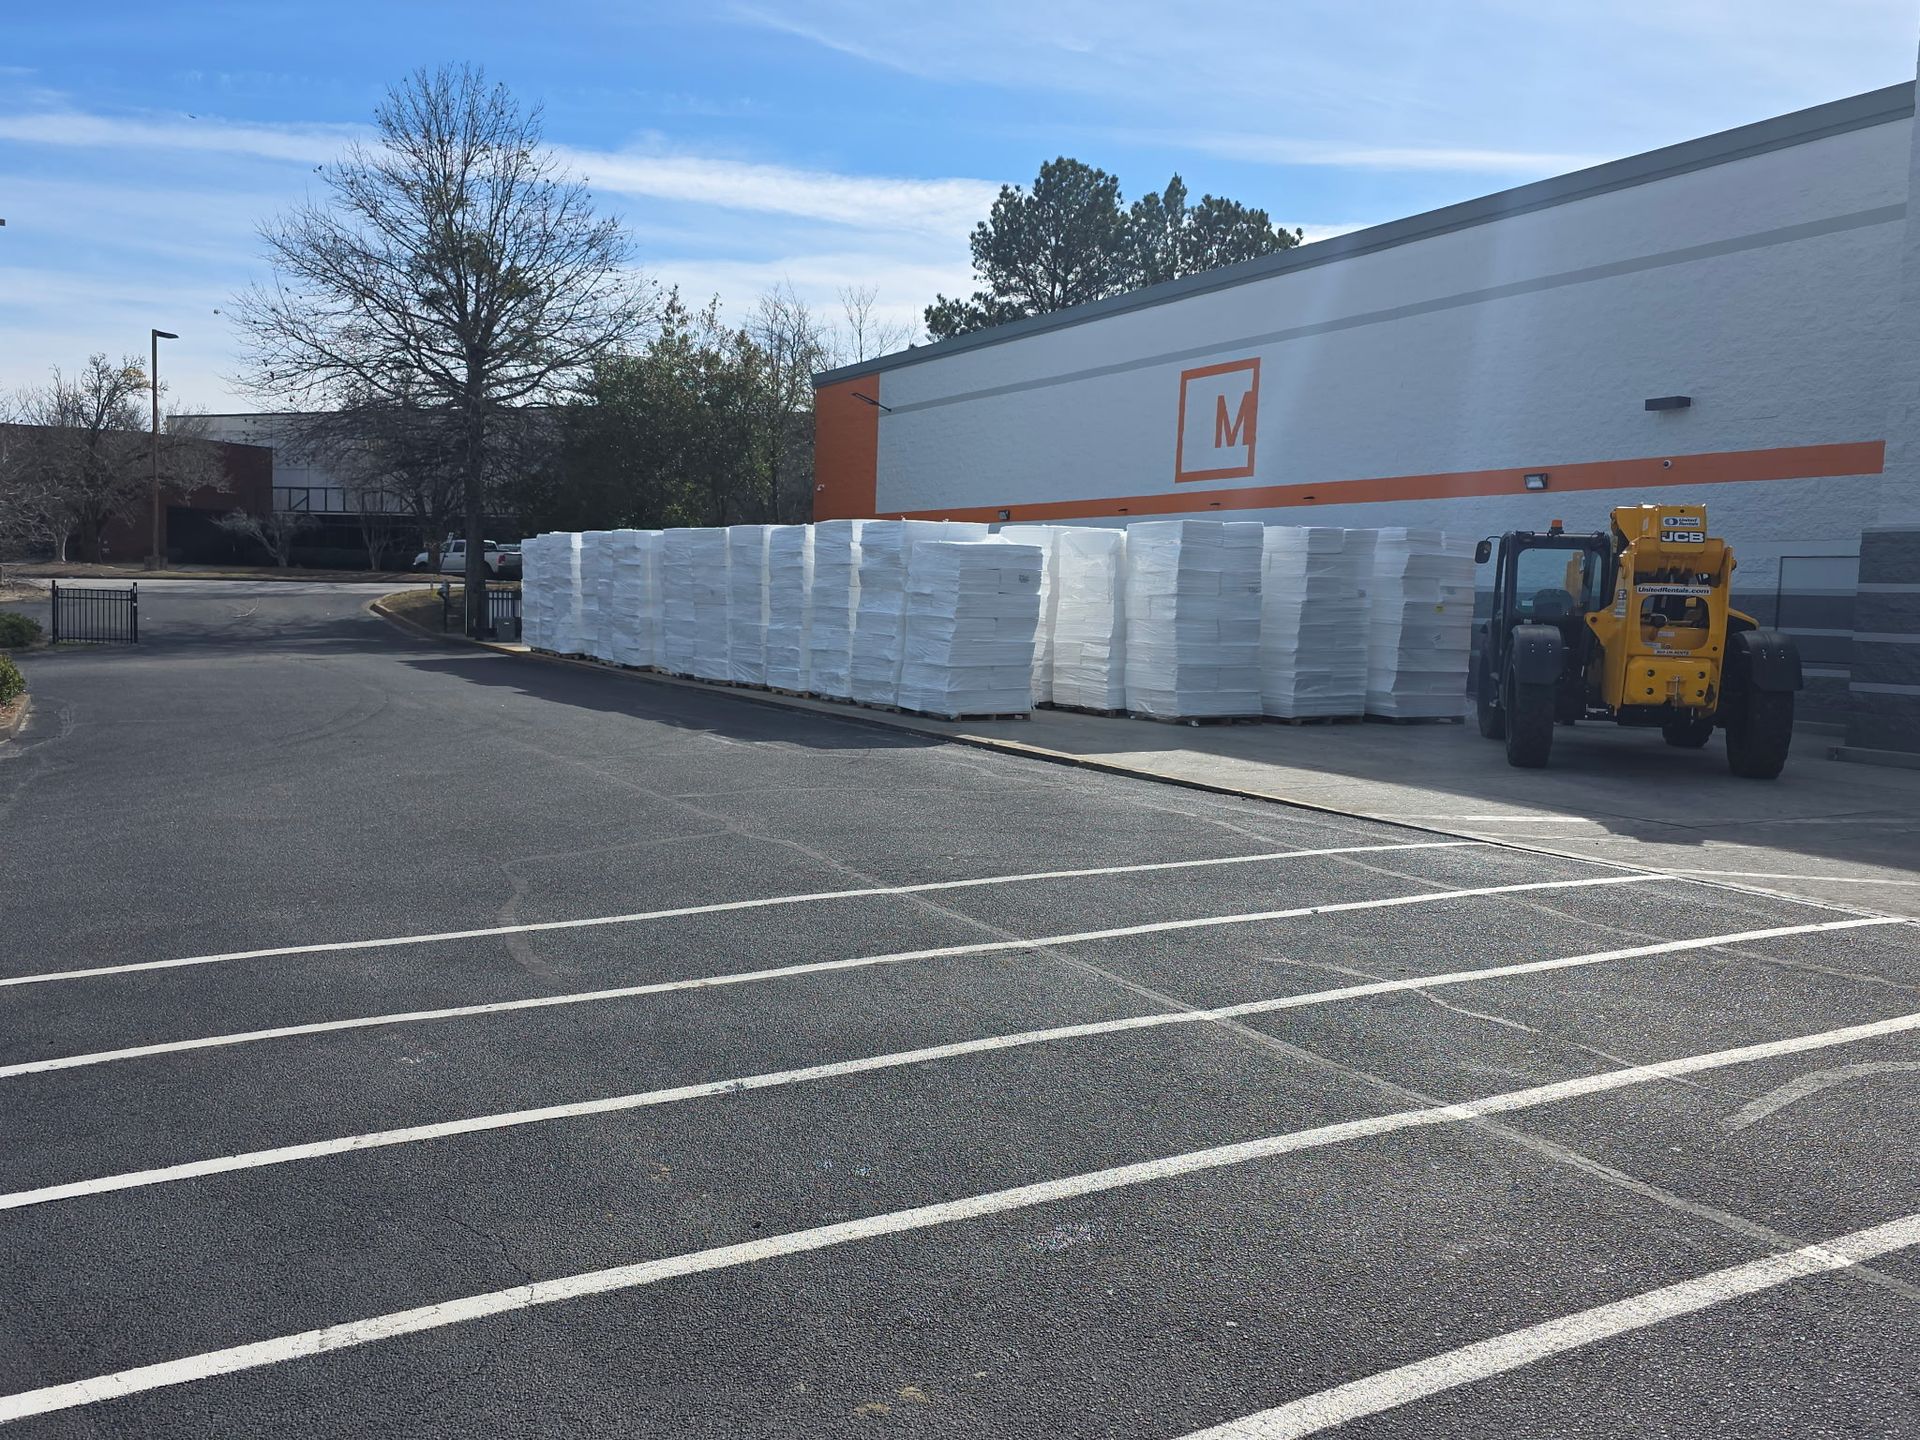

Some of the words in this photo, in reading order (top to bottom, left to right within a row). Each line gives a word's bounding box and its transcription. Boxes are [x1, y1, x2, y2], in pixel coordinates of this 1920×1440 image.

[1215, 391, 1257, 448] M
[1661, 532, 1704, 543] JCB
[1638, 586, 1710, 595] UnitedRentals.com
